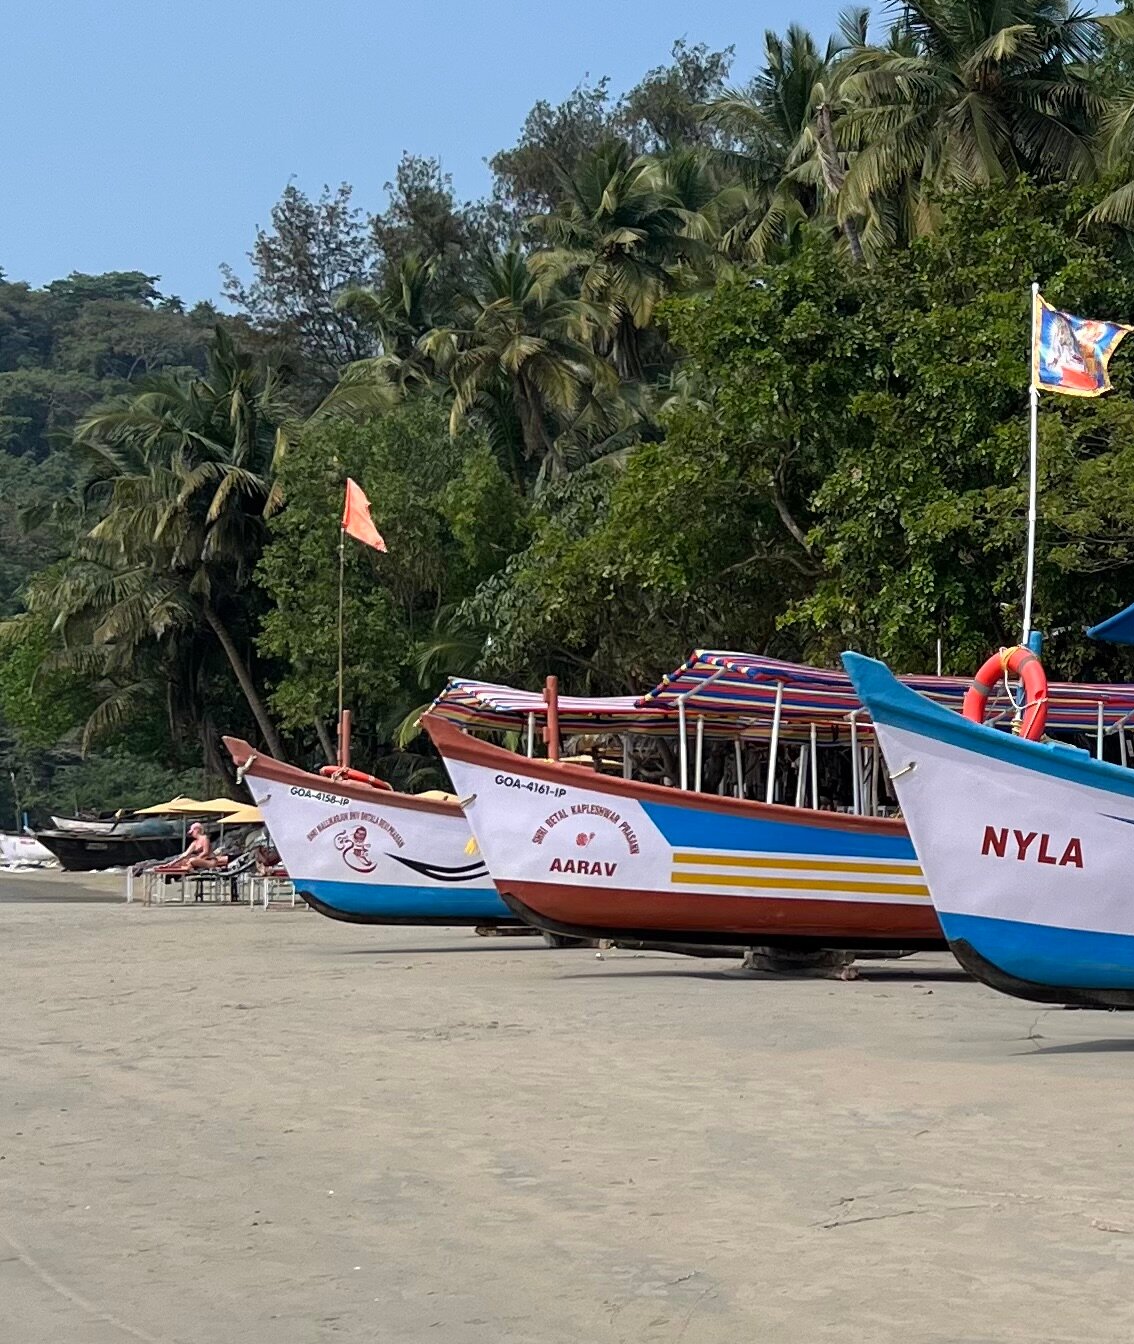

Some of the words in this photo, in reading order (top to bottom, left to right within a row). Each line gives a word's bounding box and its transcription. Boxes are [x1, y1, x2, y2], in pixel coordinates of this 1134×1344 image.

[494, 774, 567, 797] GOA-4161-IP
[290, 787, 350, 806] GOA-4158-IP
[981, 825, 1084, 869] NYLA
[549, 857, 618, 877] AARAV
